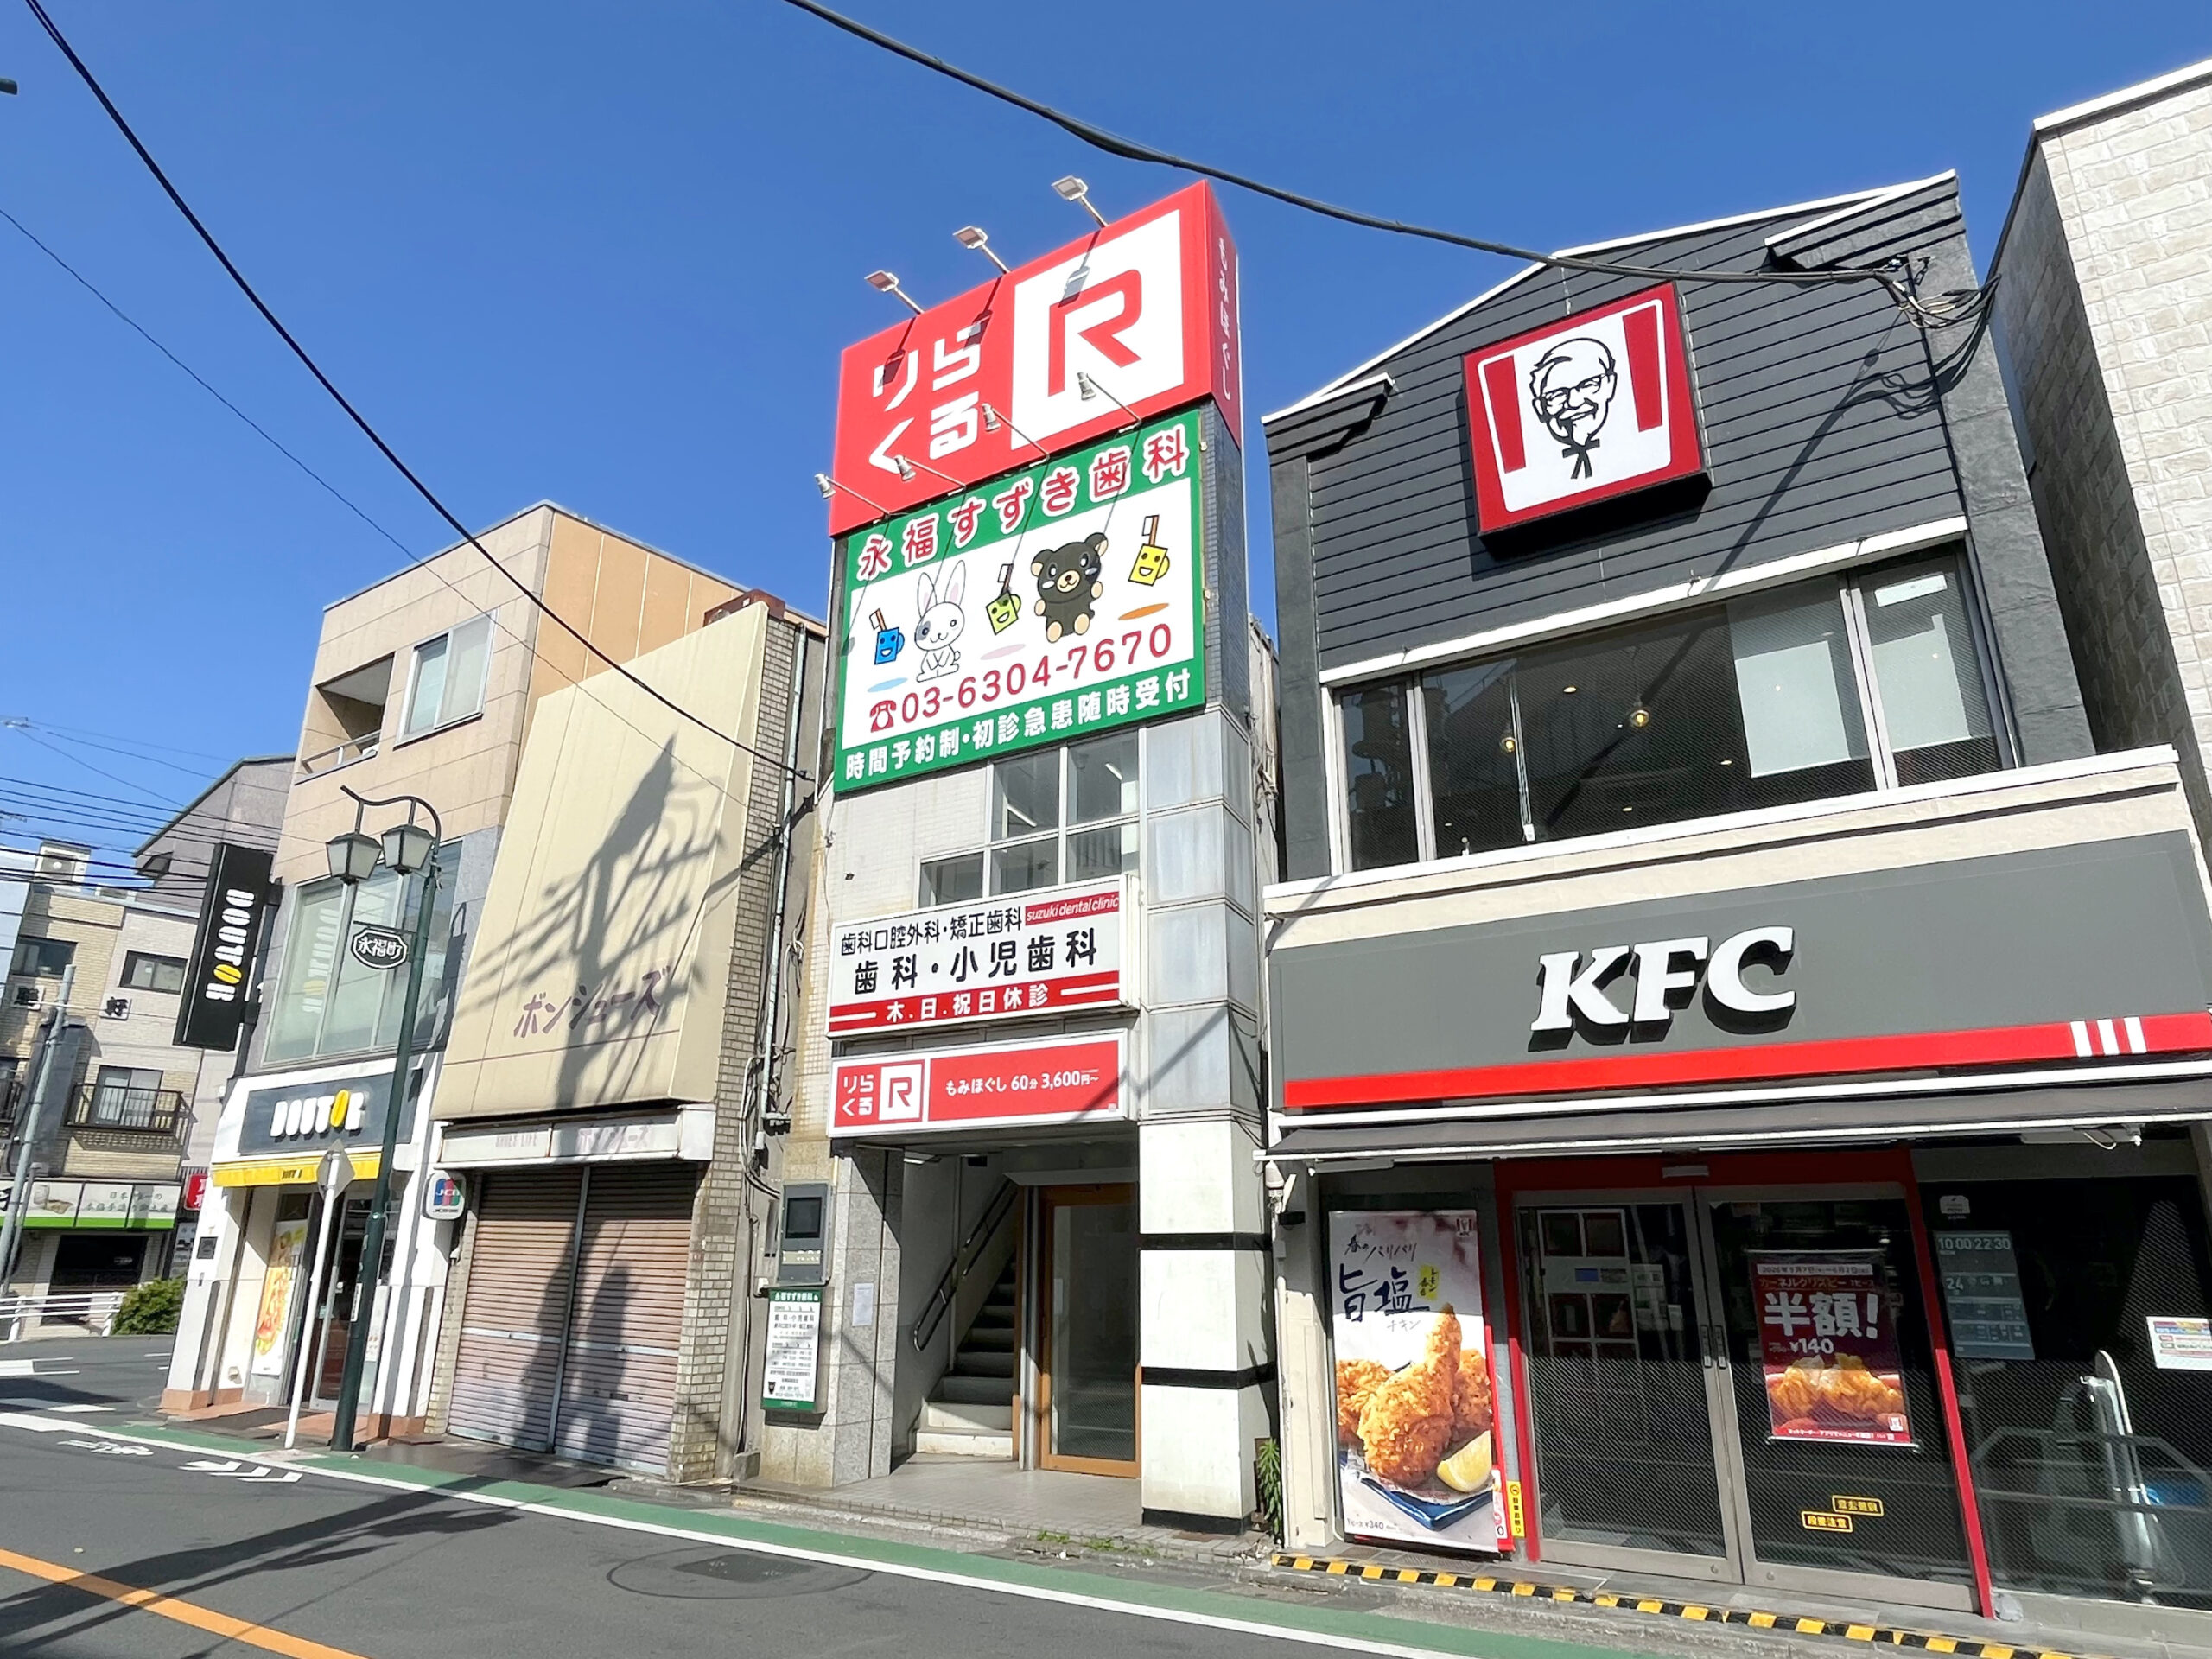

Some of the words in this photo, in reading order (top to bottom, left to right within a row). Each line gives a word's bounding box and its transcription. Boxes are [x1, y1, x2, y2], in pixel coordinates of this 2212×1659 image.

[1048, 269, 1142, 397] R
[873, 321, 982, 412] りら
[868, 391, 979, 474] くる
[858, 426, 1188, 580] 永福すずき歯科
[901, 623, 1171, 721] 03-6304-7670
[845, 668, 1191, 779] 時間予約制・初診急患随時受付
[841, 906, 1022, 956] 歯科口腔外科・矯正歯科
[1027, 905, 1059, 922] suzuki
[1059, 899, 1092, 917] dental
[1092, 894, 1119, 910] clinic
[205, 888, 255, 1001] DOUTOR
[357, 936, 403, 960] 永福町
[855, 927, 1097, 995] 歯科・小児歯科
[513, 966, 671, 1038] ボンシューズ
[1530, 925, 1797, 1033] KFC
[842, 1097, 873, 1116] くる
[843, 1074, 874, 1095] りら
[888, 1077, 912, 1108] R
[945, 1077, 1007, 1096] もみほぐし
[1010, 1074, 1038, 1090] 60分
[1340, 1263, 1431, 1322] 旨塩
[1764, 1291, 1879, 1339] 半額!
[1386, 1319, 1421, 1332] チキン
[1789, 1338, 1834, 1354] ¥140
